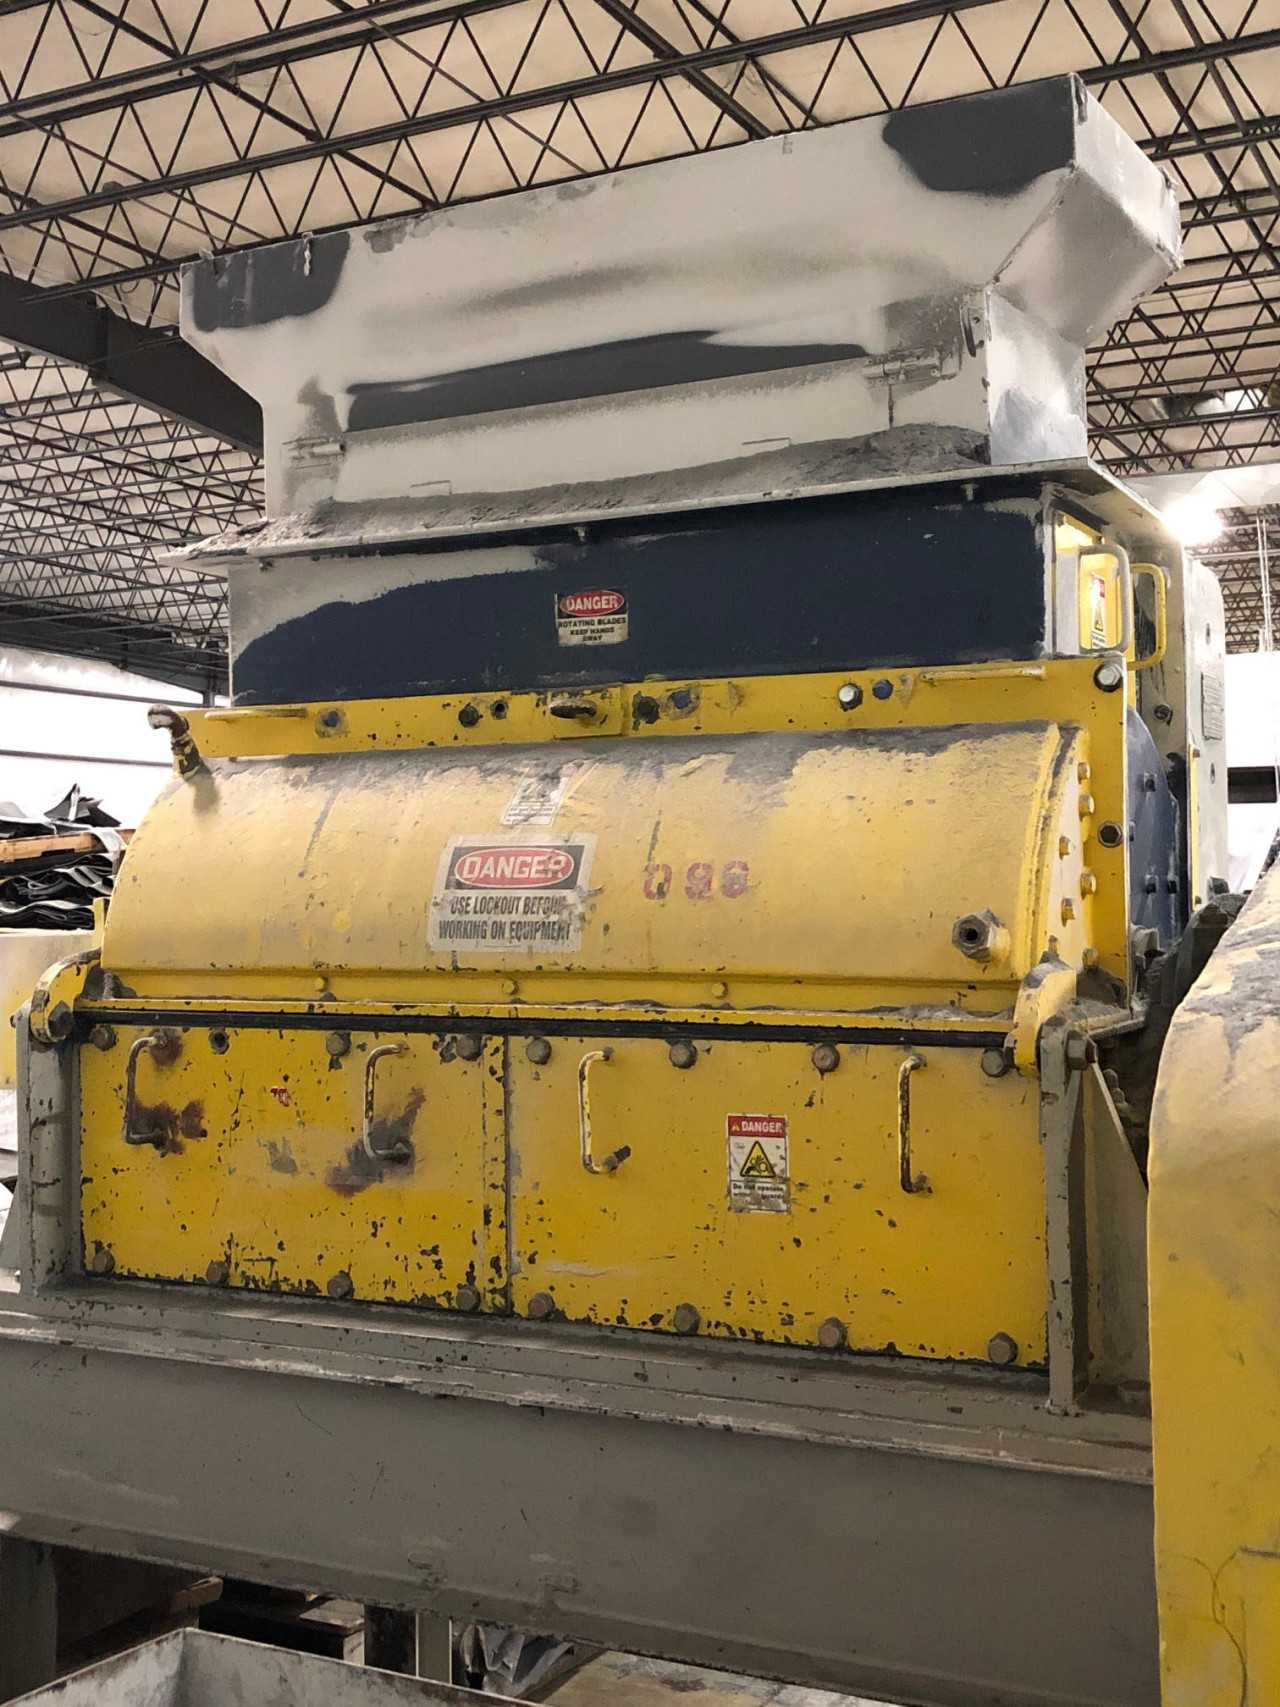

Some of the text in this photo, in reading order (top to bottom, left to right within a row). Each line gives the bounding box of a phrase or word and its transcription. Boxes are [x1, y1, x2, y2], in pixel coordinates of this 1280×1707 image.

[566, 595, 619, 611] DANGER
[597, 617, 626, 626] BLADES
[462, 856, 567, 880] DANGER
[450, 896, 471, 915] USE
[473, 896, 519, 914] LOCKOUT
[439, 920, 571, 941] WORKING ON EQUIPMENT
[741, 1121, 784, 1134] DANGER
